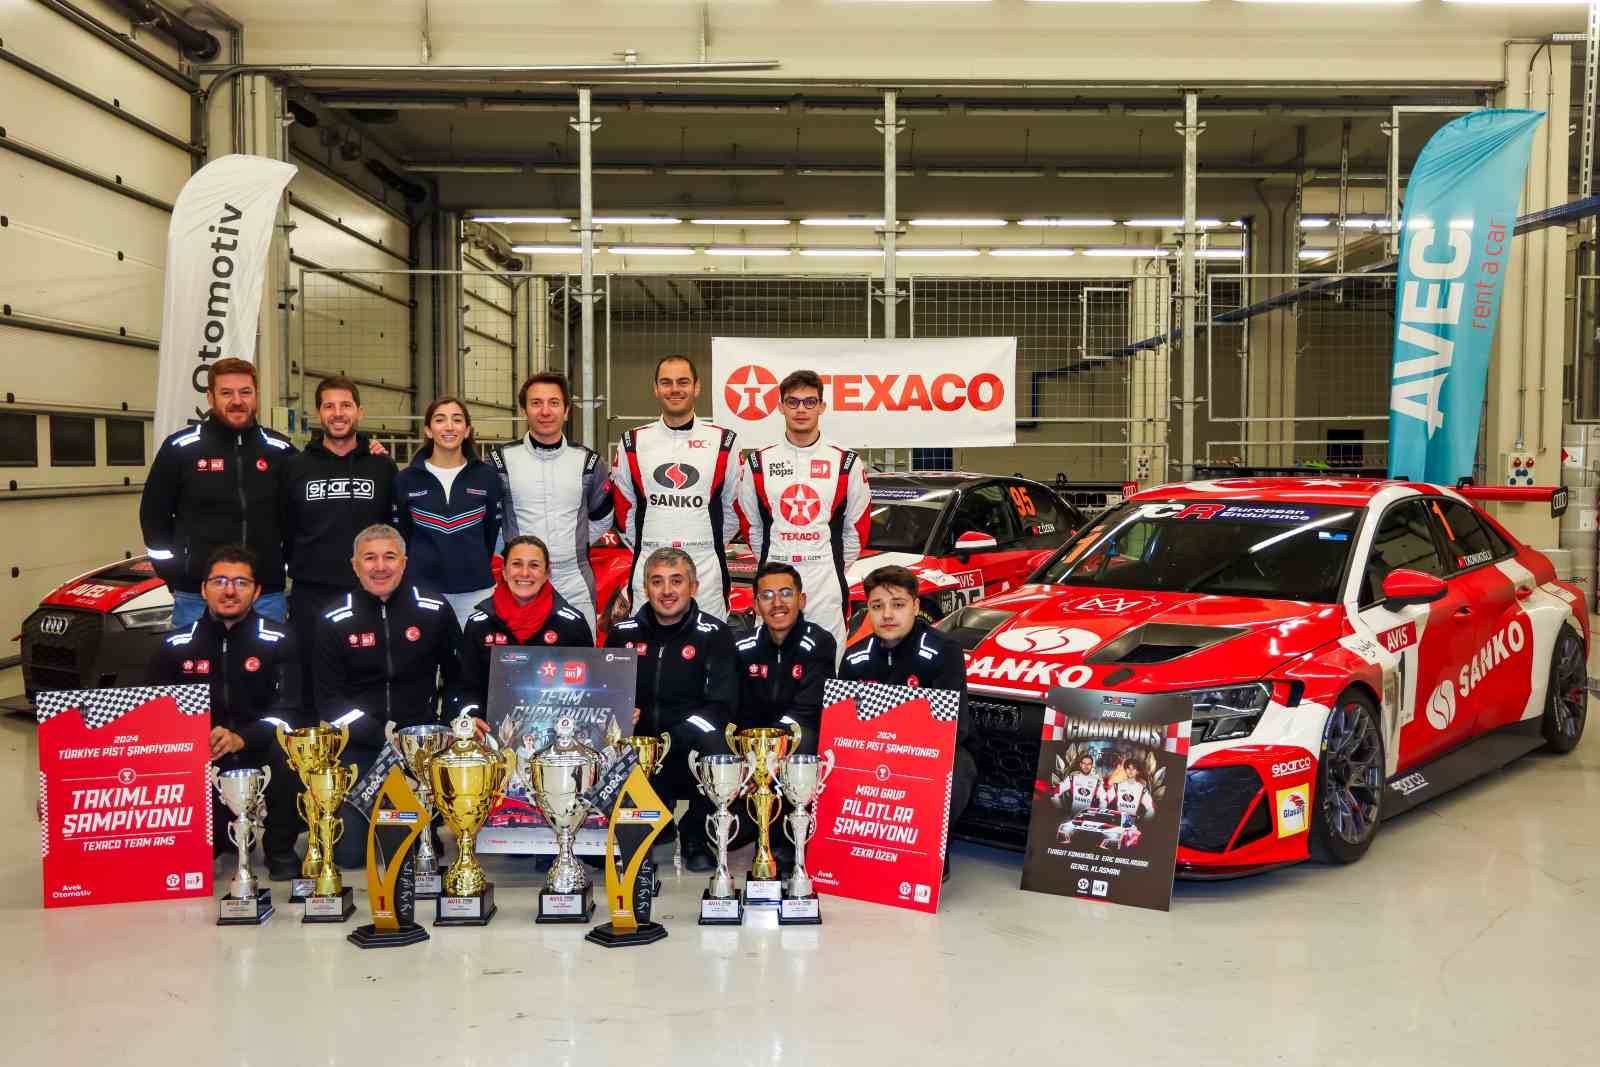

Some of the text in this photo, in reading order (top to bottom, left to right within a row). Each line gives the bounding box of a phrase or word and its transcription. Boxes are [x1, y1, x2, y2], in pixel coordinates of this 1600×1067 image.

[1472, 221, 1508, 330] rent a car
[191, 202, 243, 393] Otomotiv
[1390, 218, 1471, 440] AVEC
[308, 479, 373, 497] sparco
[649, 494, 703, 508] SANKO
[1008, 486, 1037, 517] 95
[1226, 506, 1305, 516] European
[1219, 511, 1311, 521] Endurance
[780, 532, 820, 541] TEXACO
[1386, 627, 1408, 652] AVIS
[1458, 621, 1525, 697] SANKO
[537, 688, 585, 705] TEAM
[1102, 711, 1132, 719] OVERALL
[113, 735, 139, 744] 2024
[877, 731, 897, 740] 2024
[1067, 719, 1161, 744] CHAMPIONS
[1272, 757, 1311, 778] sparco
[72, 784, 185, 810] TAKIMLAR
[361, 775, 385, 801] 2024
[600, 774, 624, 800] 2024
[880, 787, 906, 800] GRUP
[842, 798, 914, 823] PİLOTLAR
[62, 807, 192, 837] ŞAMPİYONU
[833, 817, 919, 845] ŞAMPİYONU
[83, 836, 175, 851] TEXACO TEAM AMS
[875, 848, 898, 863] ÖZEN
[617, 896, 624, 910] 1
